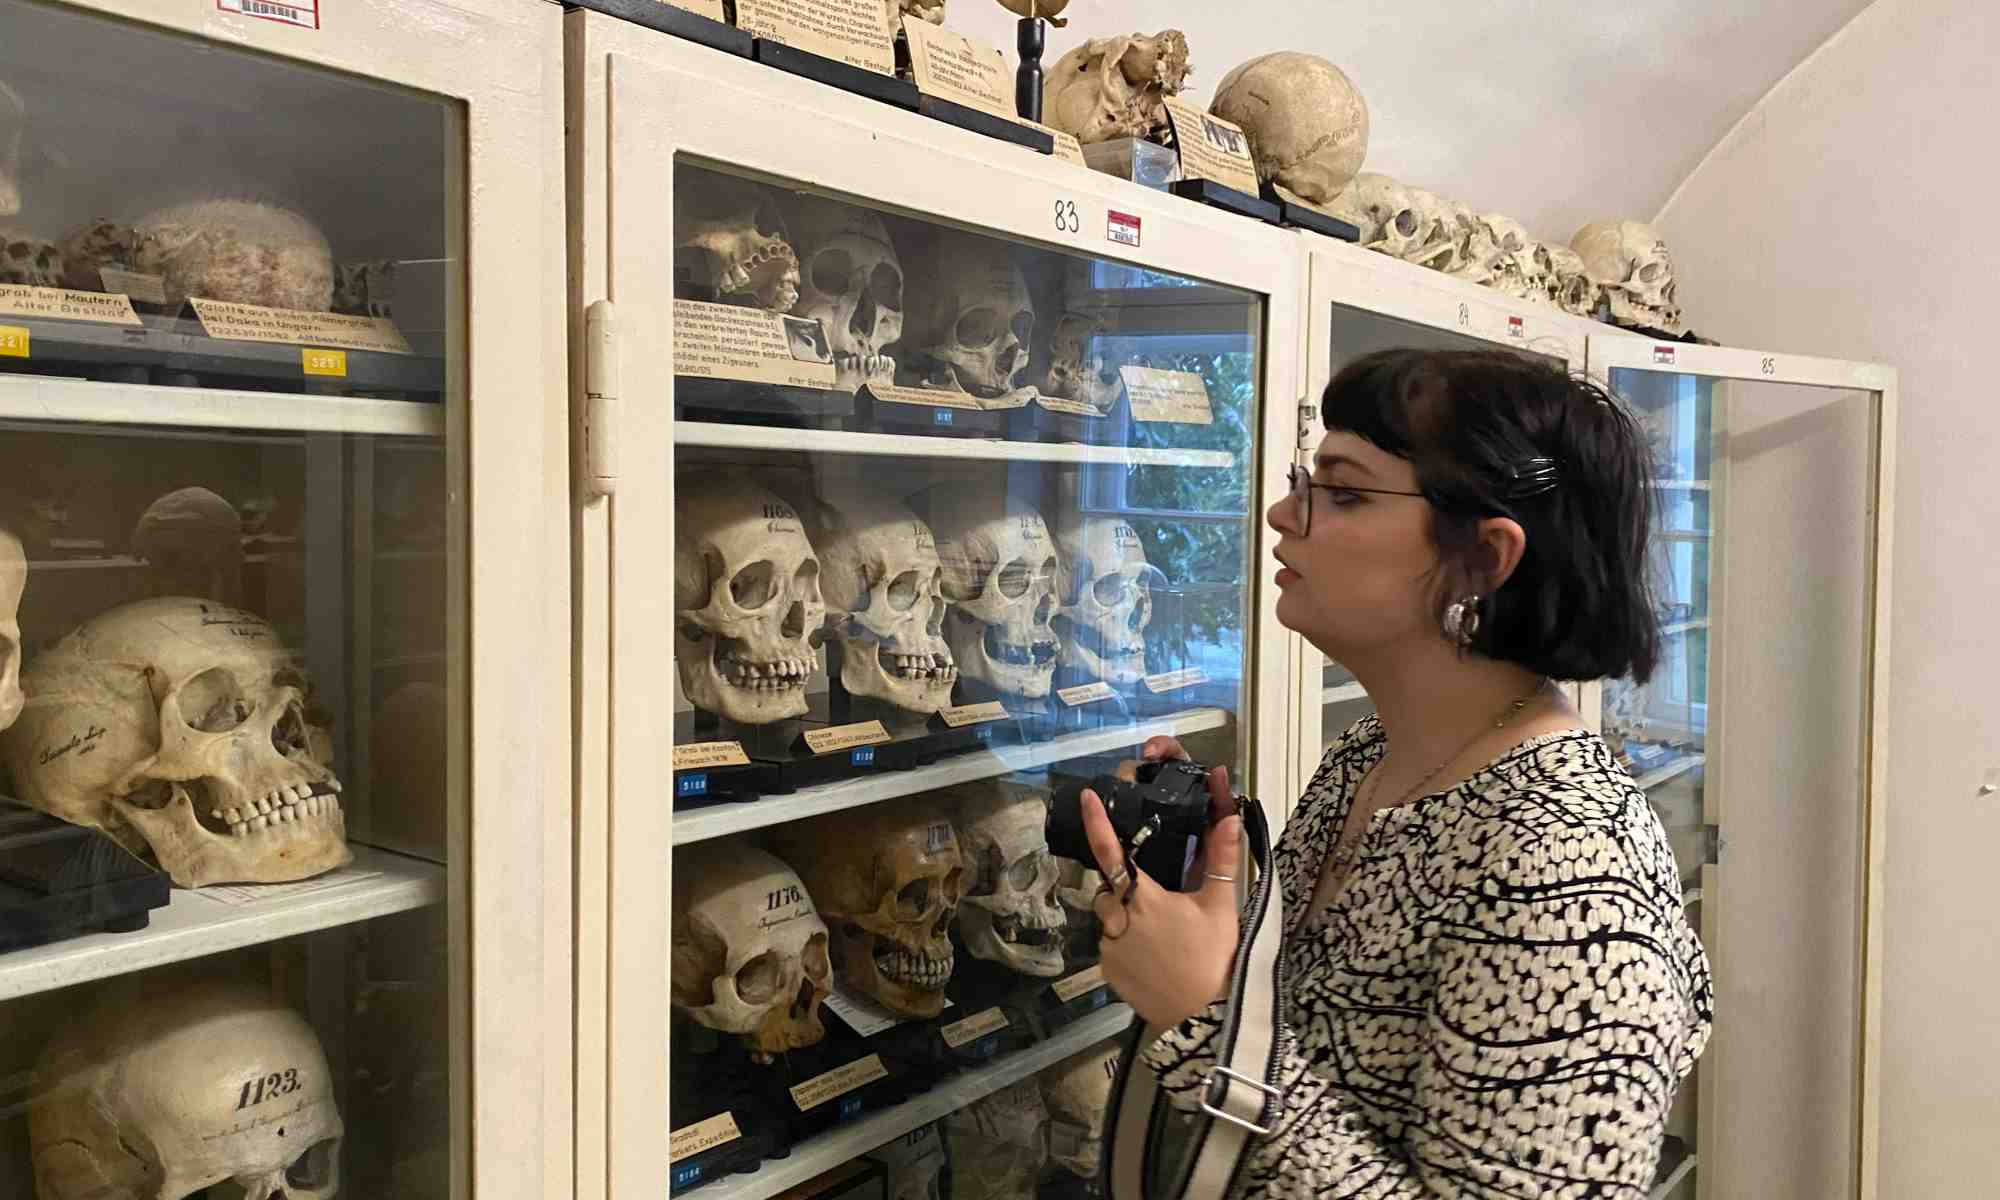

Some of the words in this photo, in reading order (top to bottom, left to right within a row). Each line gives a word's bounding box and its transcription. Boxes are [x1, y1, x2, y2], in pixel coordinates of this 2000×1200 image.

[1055, 200, 1079, 233] 83
[1761, 358, 1775, 375] 85
[235, 1068, 301, 1112] 1123.
